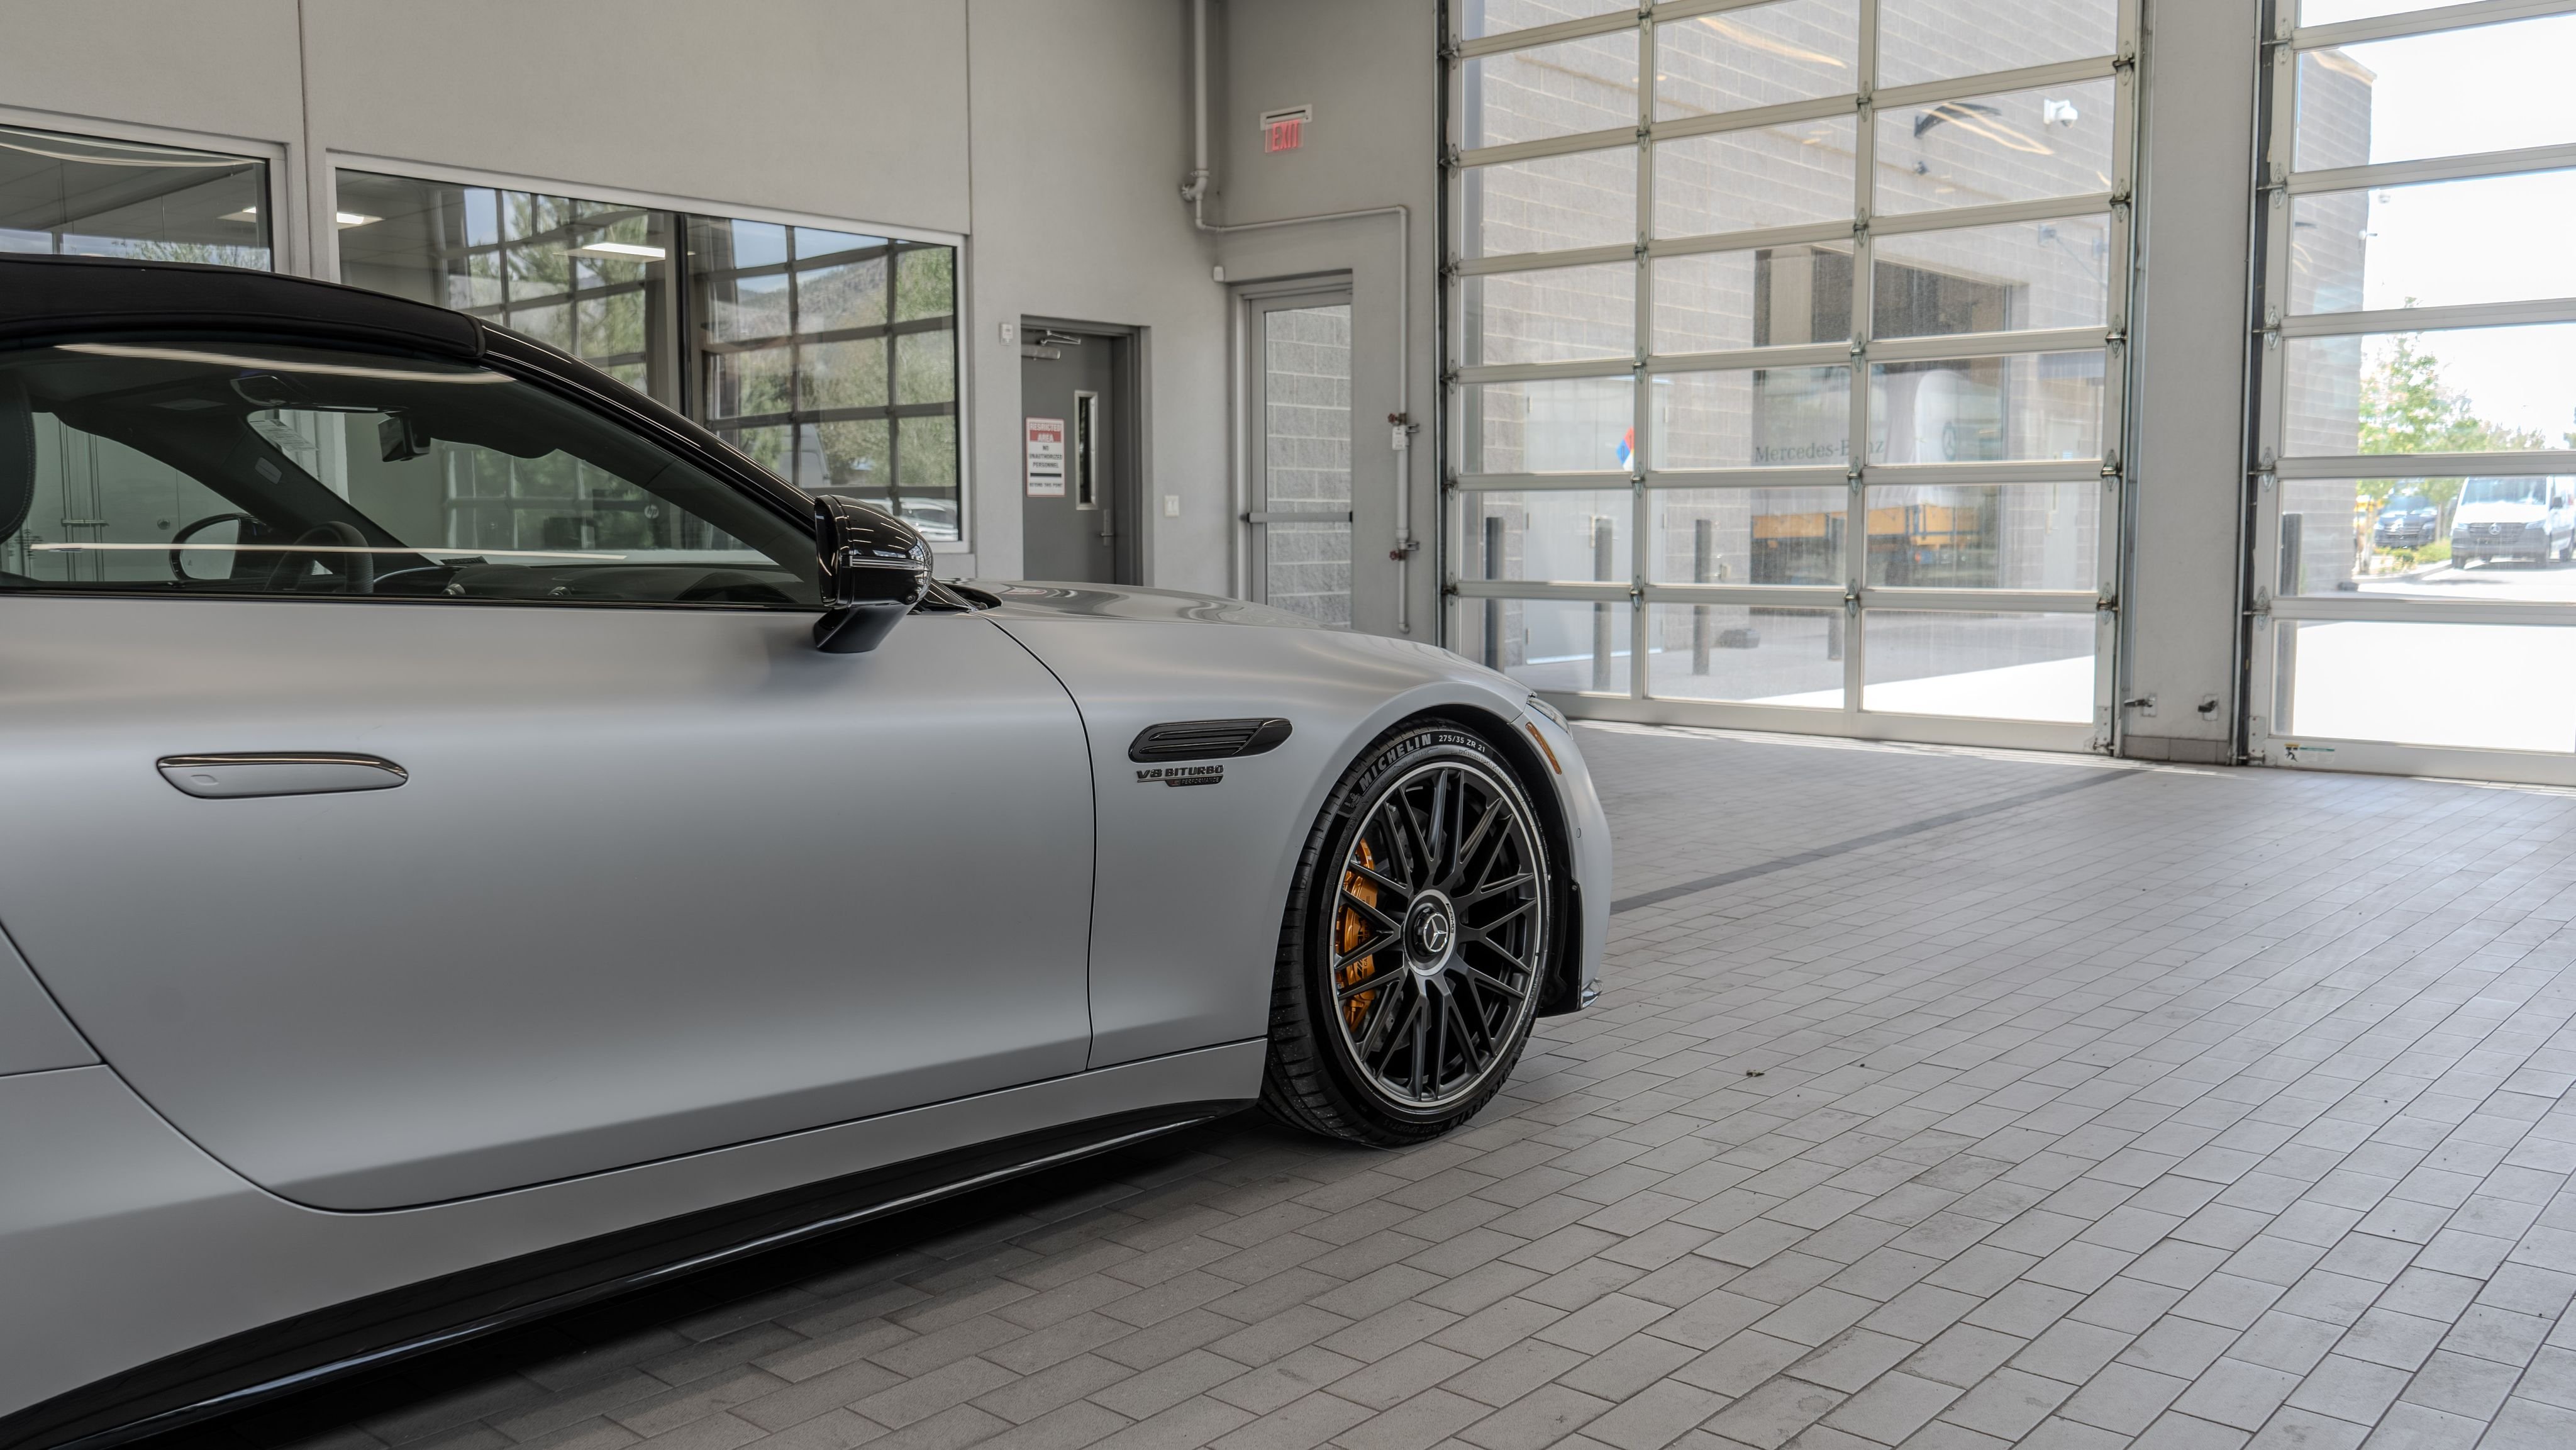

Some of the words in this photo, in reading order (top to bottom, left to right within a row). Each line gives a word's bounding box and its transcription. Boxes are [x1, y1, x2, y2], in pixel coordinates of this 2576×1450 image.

[1272, 120, 1299, 151] EXIT
[1030, 423, 1062, 432] RESTRICTED
[1038, 433, 1054, 442] AREA
[1755, 439, 1884, 462] Mercedes-Bz
[644, 505, 659, 518] hp
[1358, 733, 1431, 793] MICHELIN
[1438, 735, 1465, 744] 275/35
[1466, 739, 1477, 748] ZR
[1478, 744, 1486, 752] 21
[1136, 769, 1162, 779] V8
[1165, 764, 1224, 777] BITURBO
